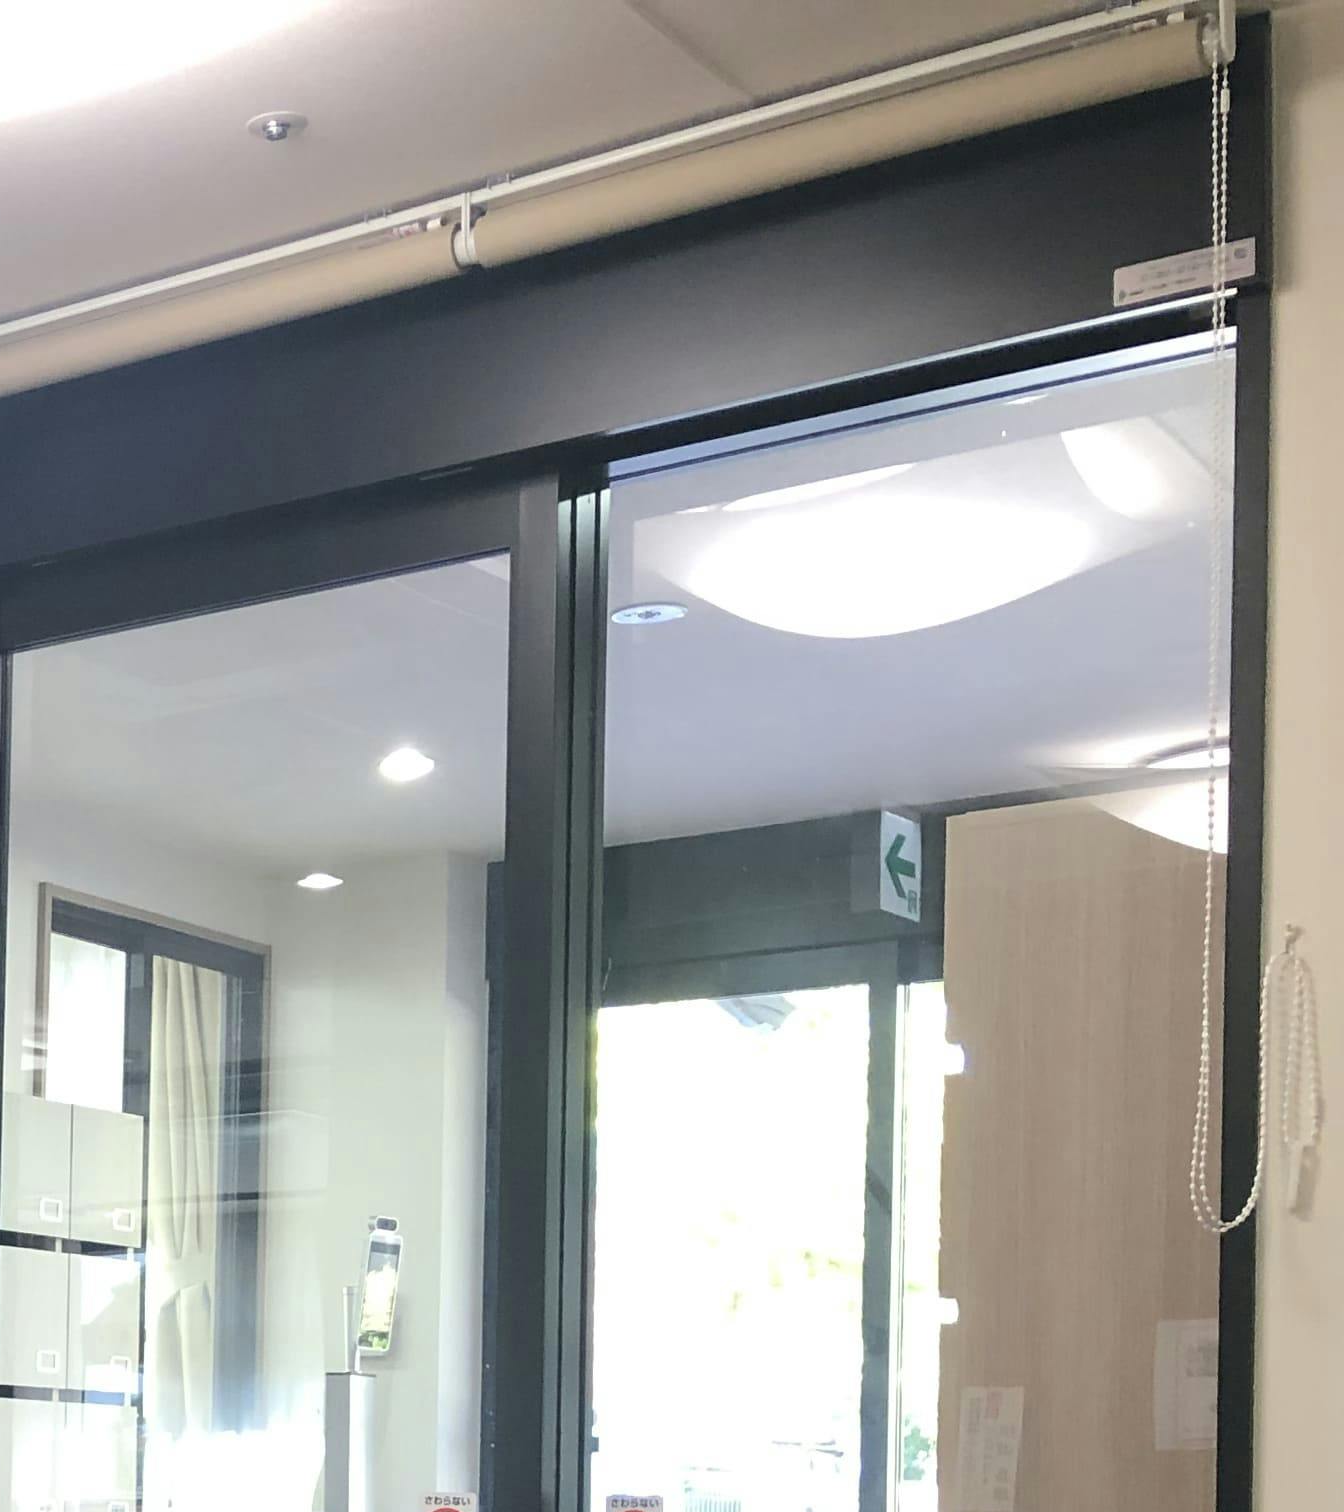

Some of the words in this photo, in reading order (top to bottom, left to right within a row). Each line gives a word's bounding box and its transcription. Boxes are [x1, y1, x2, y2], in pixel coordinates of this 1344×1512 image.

[424, 1495, 471, 1506] さわらない
[611, 1498, 659, 1508] さわらない
